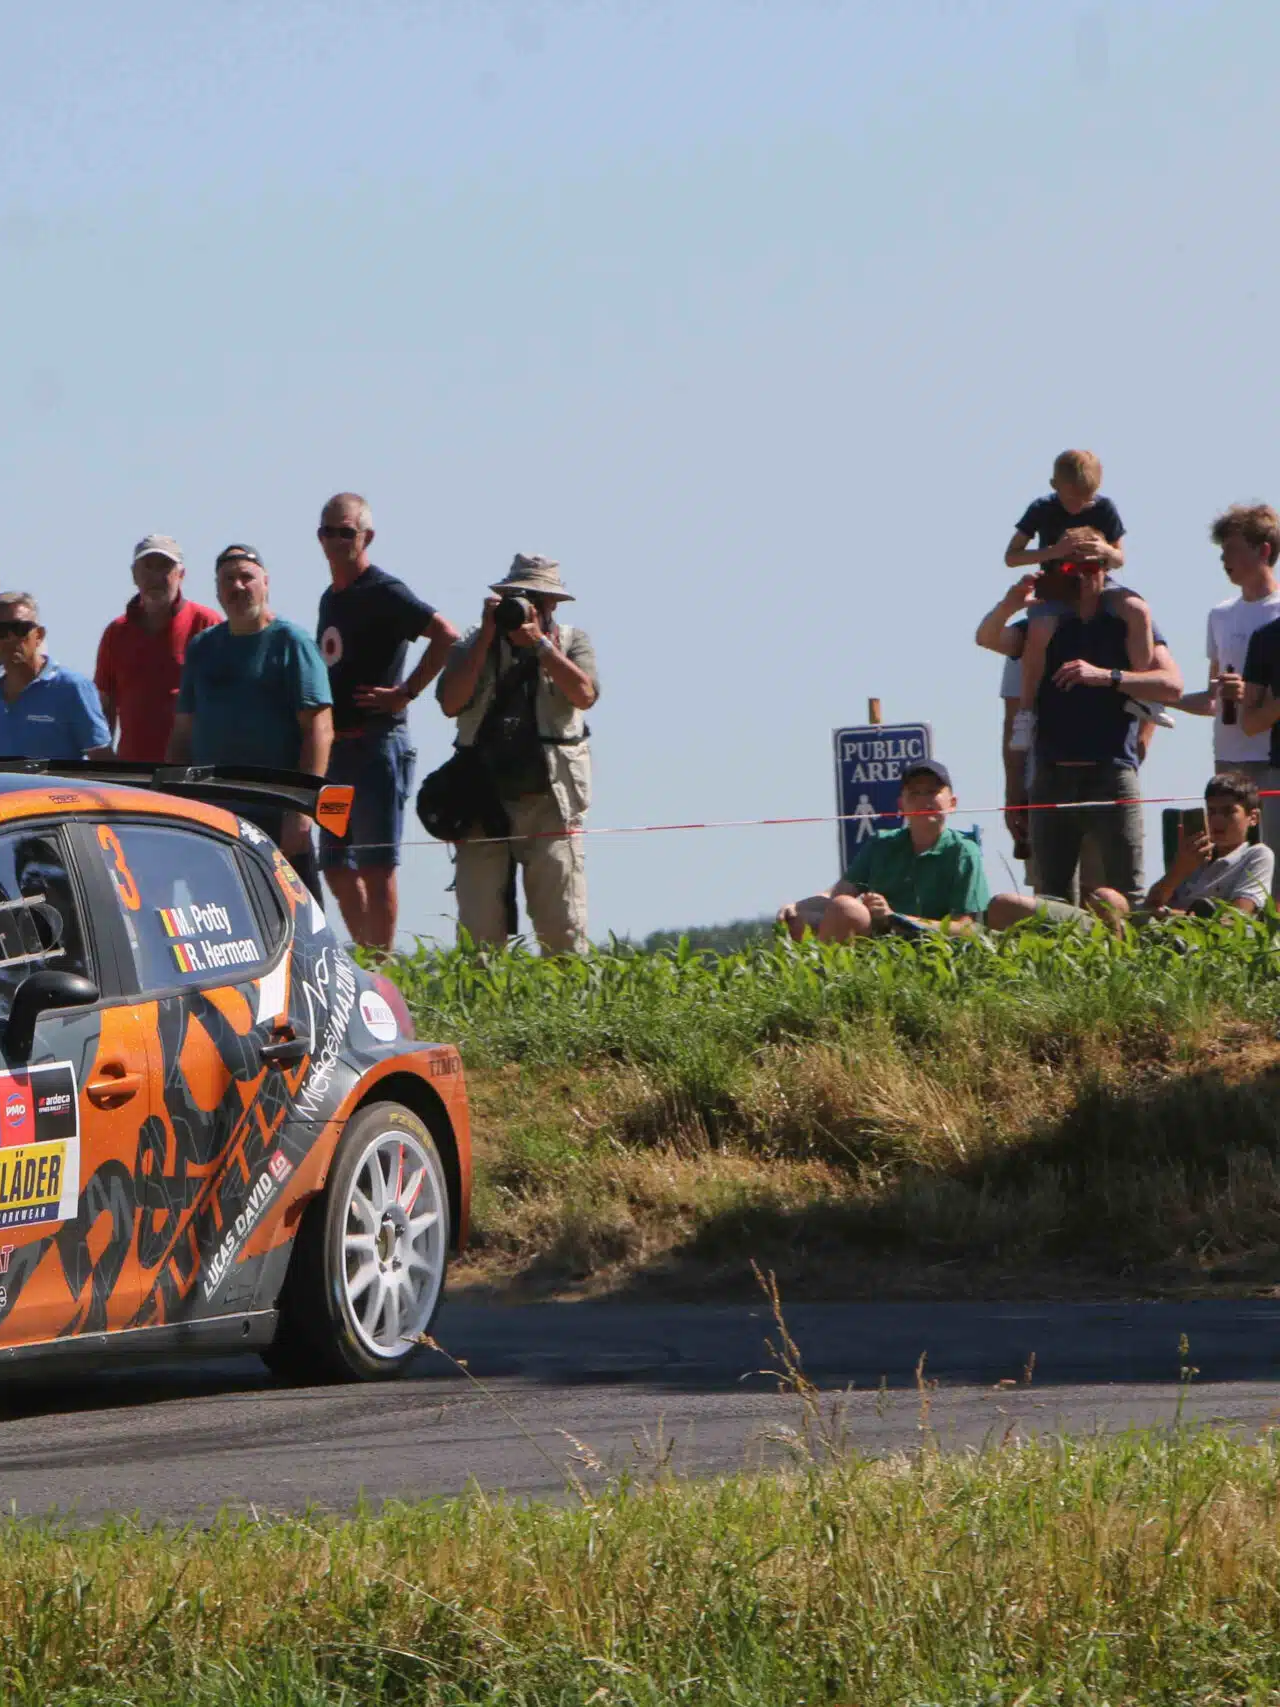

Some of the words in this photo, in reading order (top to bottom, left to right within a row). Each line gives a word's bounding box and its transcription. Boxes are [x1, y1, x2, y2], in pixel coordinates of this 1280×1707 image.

[843, 738, 922, 762] PUBLIC
[850, 760, 913, 783] ARE
[96, 824, 141, 911] 3
[171, 907, 196, 937] M.
[191, 902, 233, 935] Potty
[184, 942, 207, 971] R.
[200, 938, 260, 969] Herman
[5, 1103, 26, 1117] PMO
[45, 1093, 71, 1107] ardeca
[204, 1230, 236, 1299] LUCAS
[234, 1171, 274, 1237] DAVID
